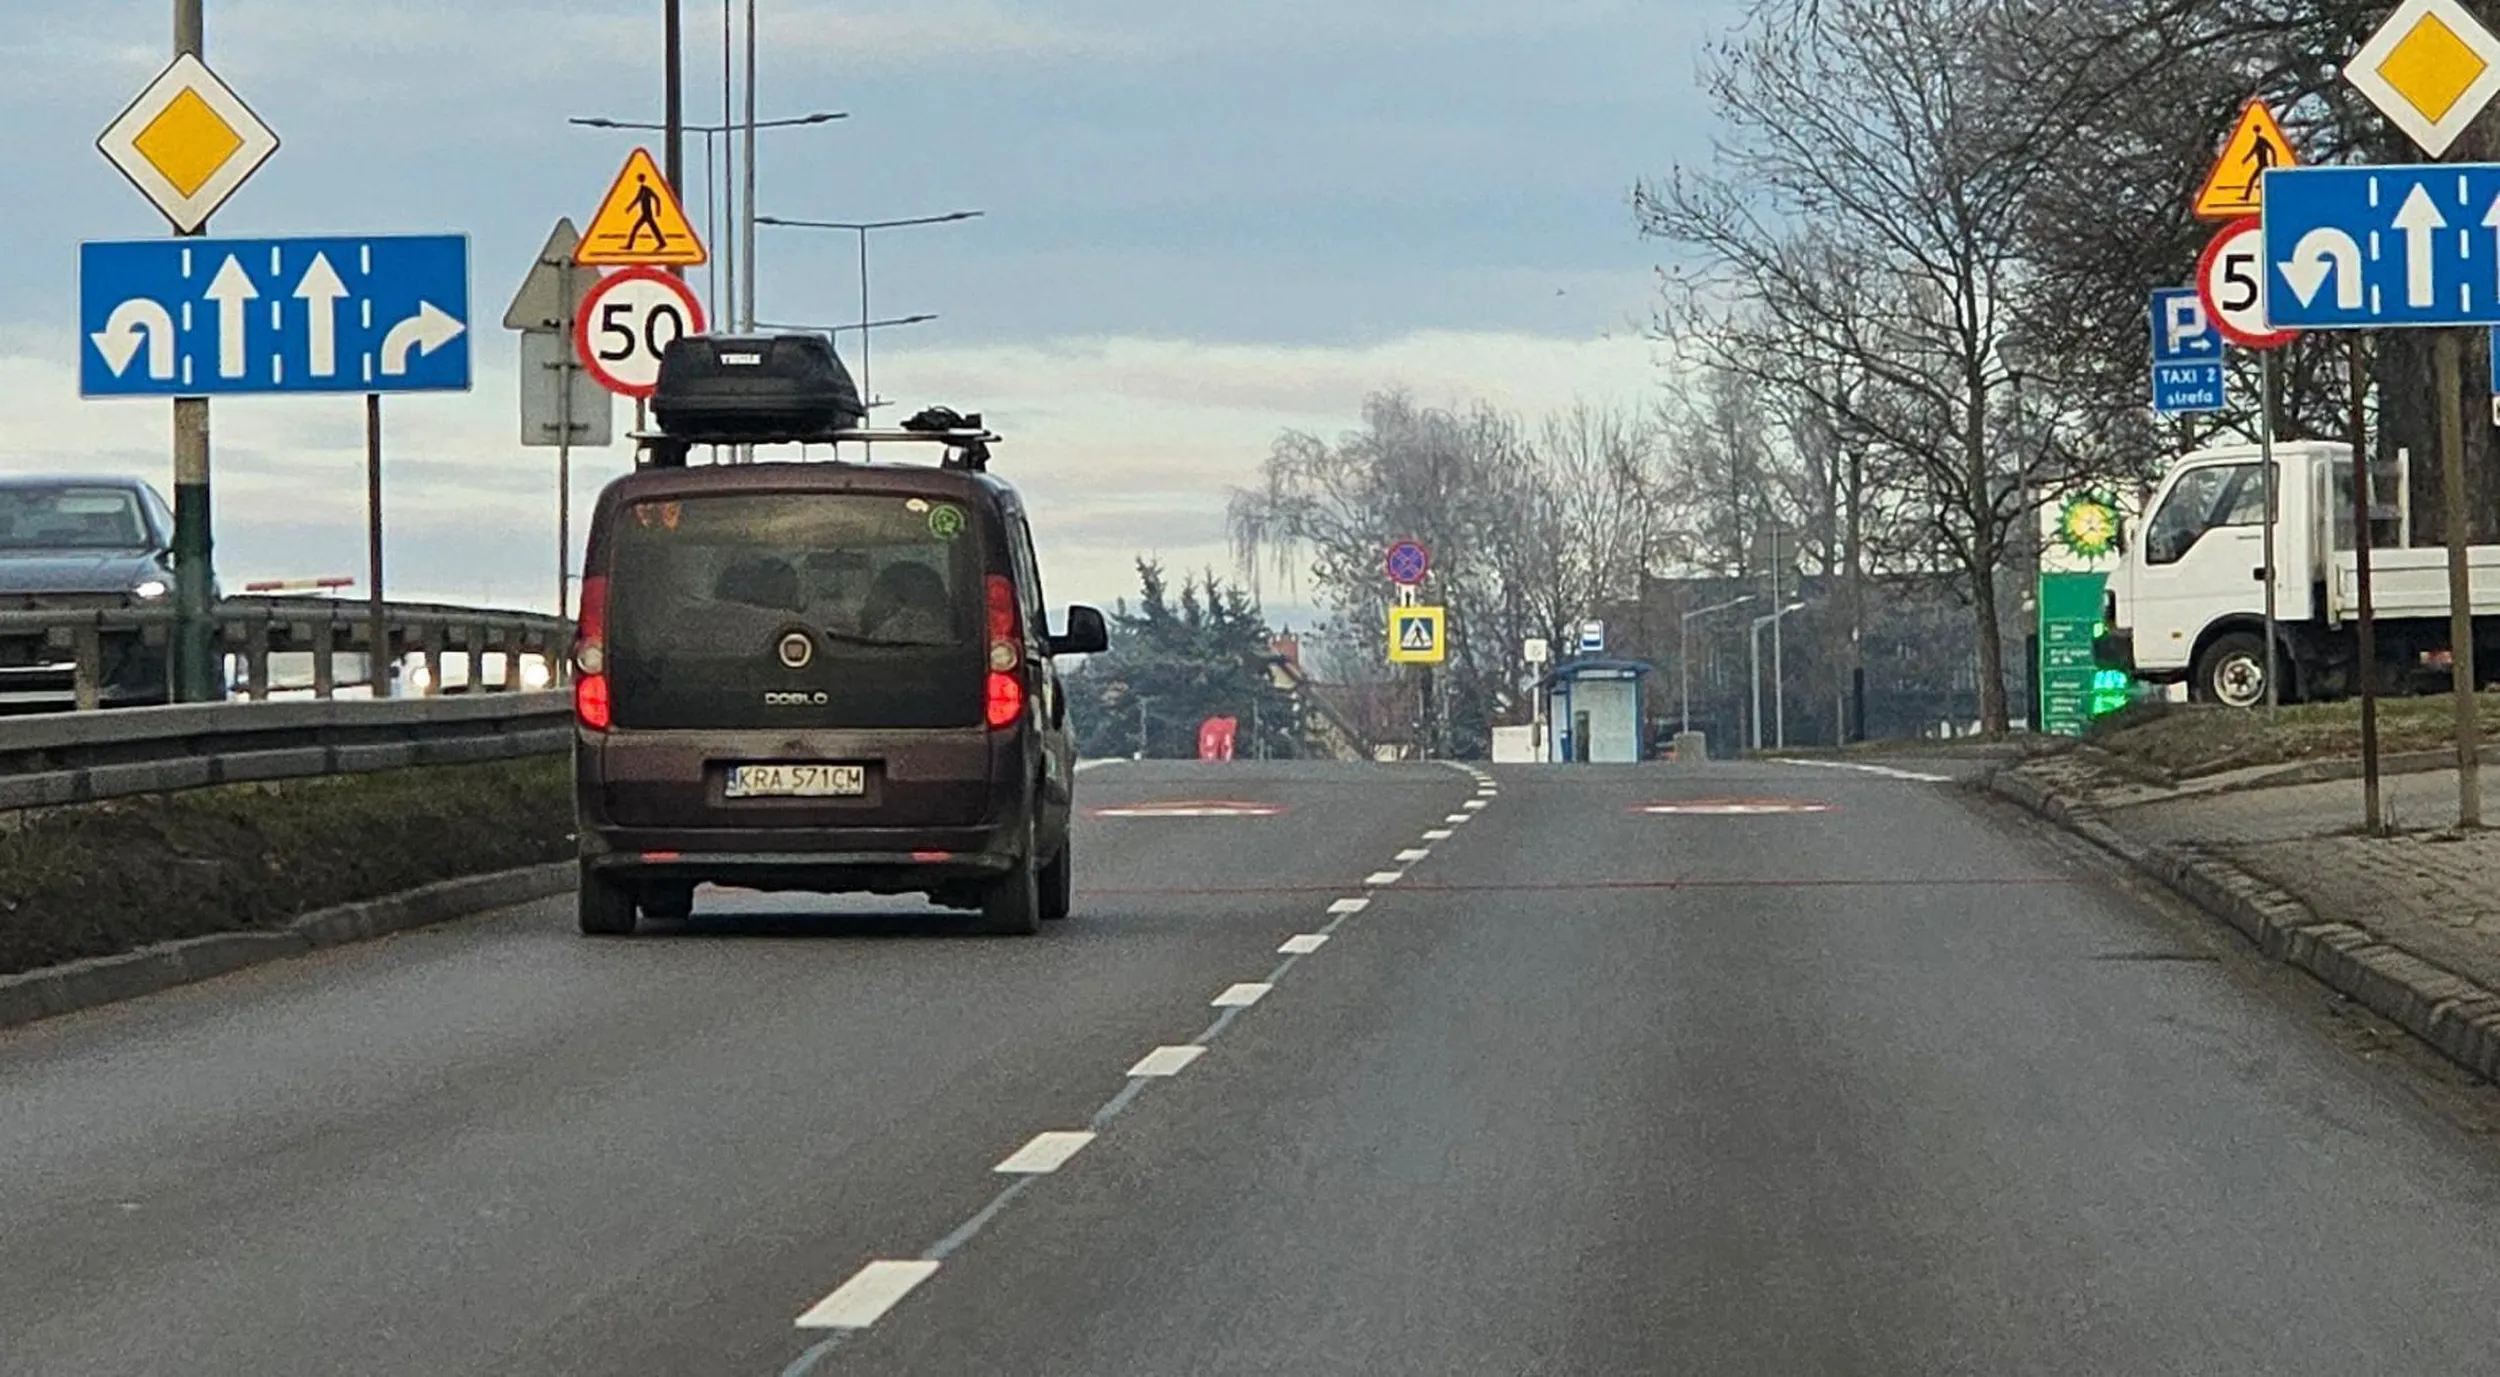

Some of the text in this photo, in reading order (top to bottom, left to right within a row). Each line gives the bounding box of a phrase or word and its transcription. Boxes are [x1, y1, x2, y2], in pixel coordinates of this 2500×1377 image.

[2222, 254, 2258, 312] 5
[599, 303, 683, 361] 50
[2166, 296, 2207, 353] P
[2161, 367, 2216, 384] TAXI 2
[2167, 389, 2213, 406] strefa
[764, 692, 828, 705] DOBLO
[740, 769, 781, 788] KRA
